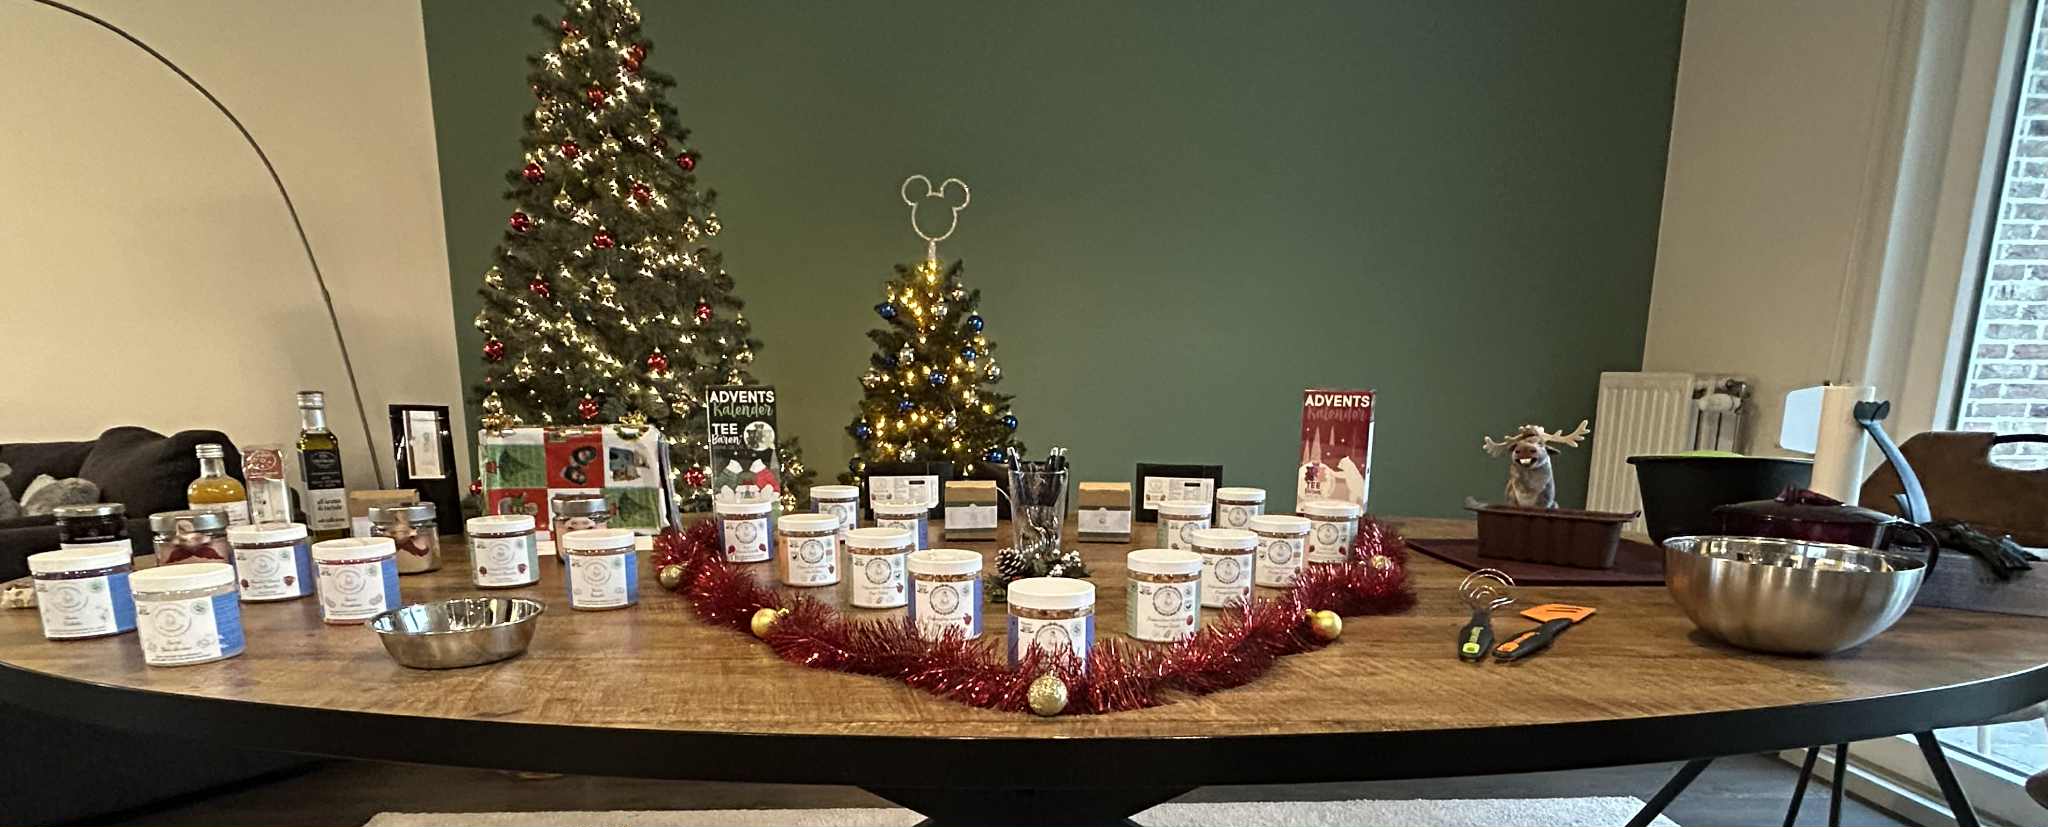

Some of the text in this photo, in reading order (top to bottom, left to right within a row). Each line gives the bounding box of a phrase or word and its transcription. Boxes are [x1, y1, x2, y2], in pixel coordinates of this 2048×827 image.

[710, 391, 774, 403] ADVENTS
[1305, 394, 1370, 408] ADVENTS
[714, 402, 773, 417] Kalender
[711, 423, 738, 435] TEE
[1306, 481, 1321, 490] TEE
